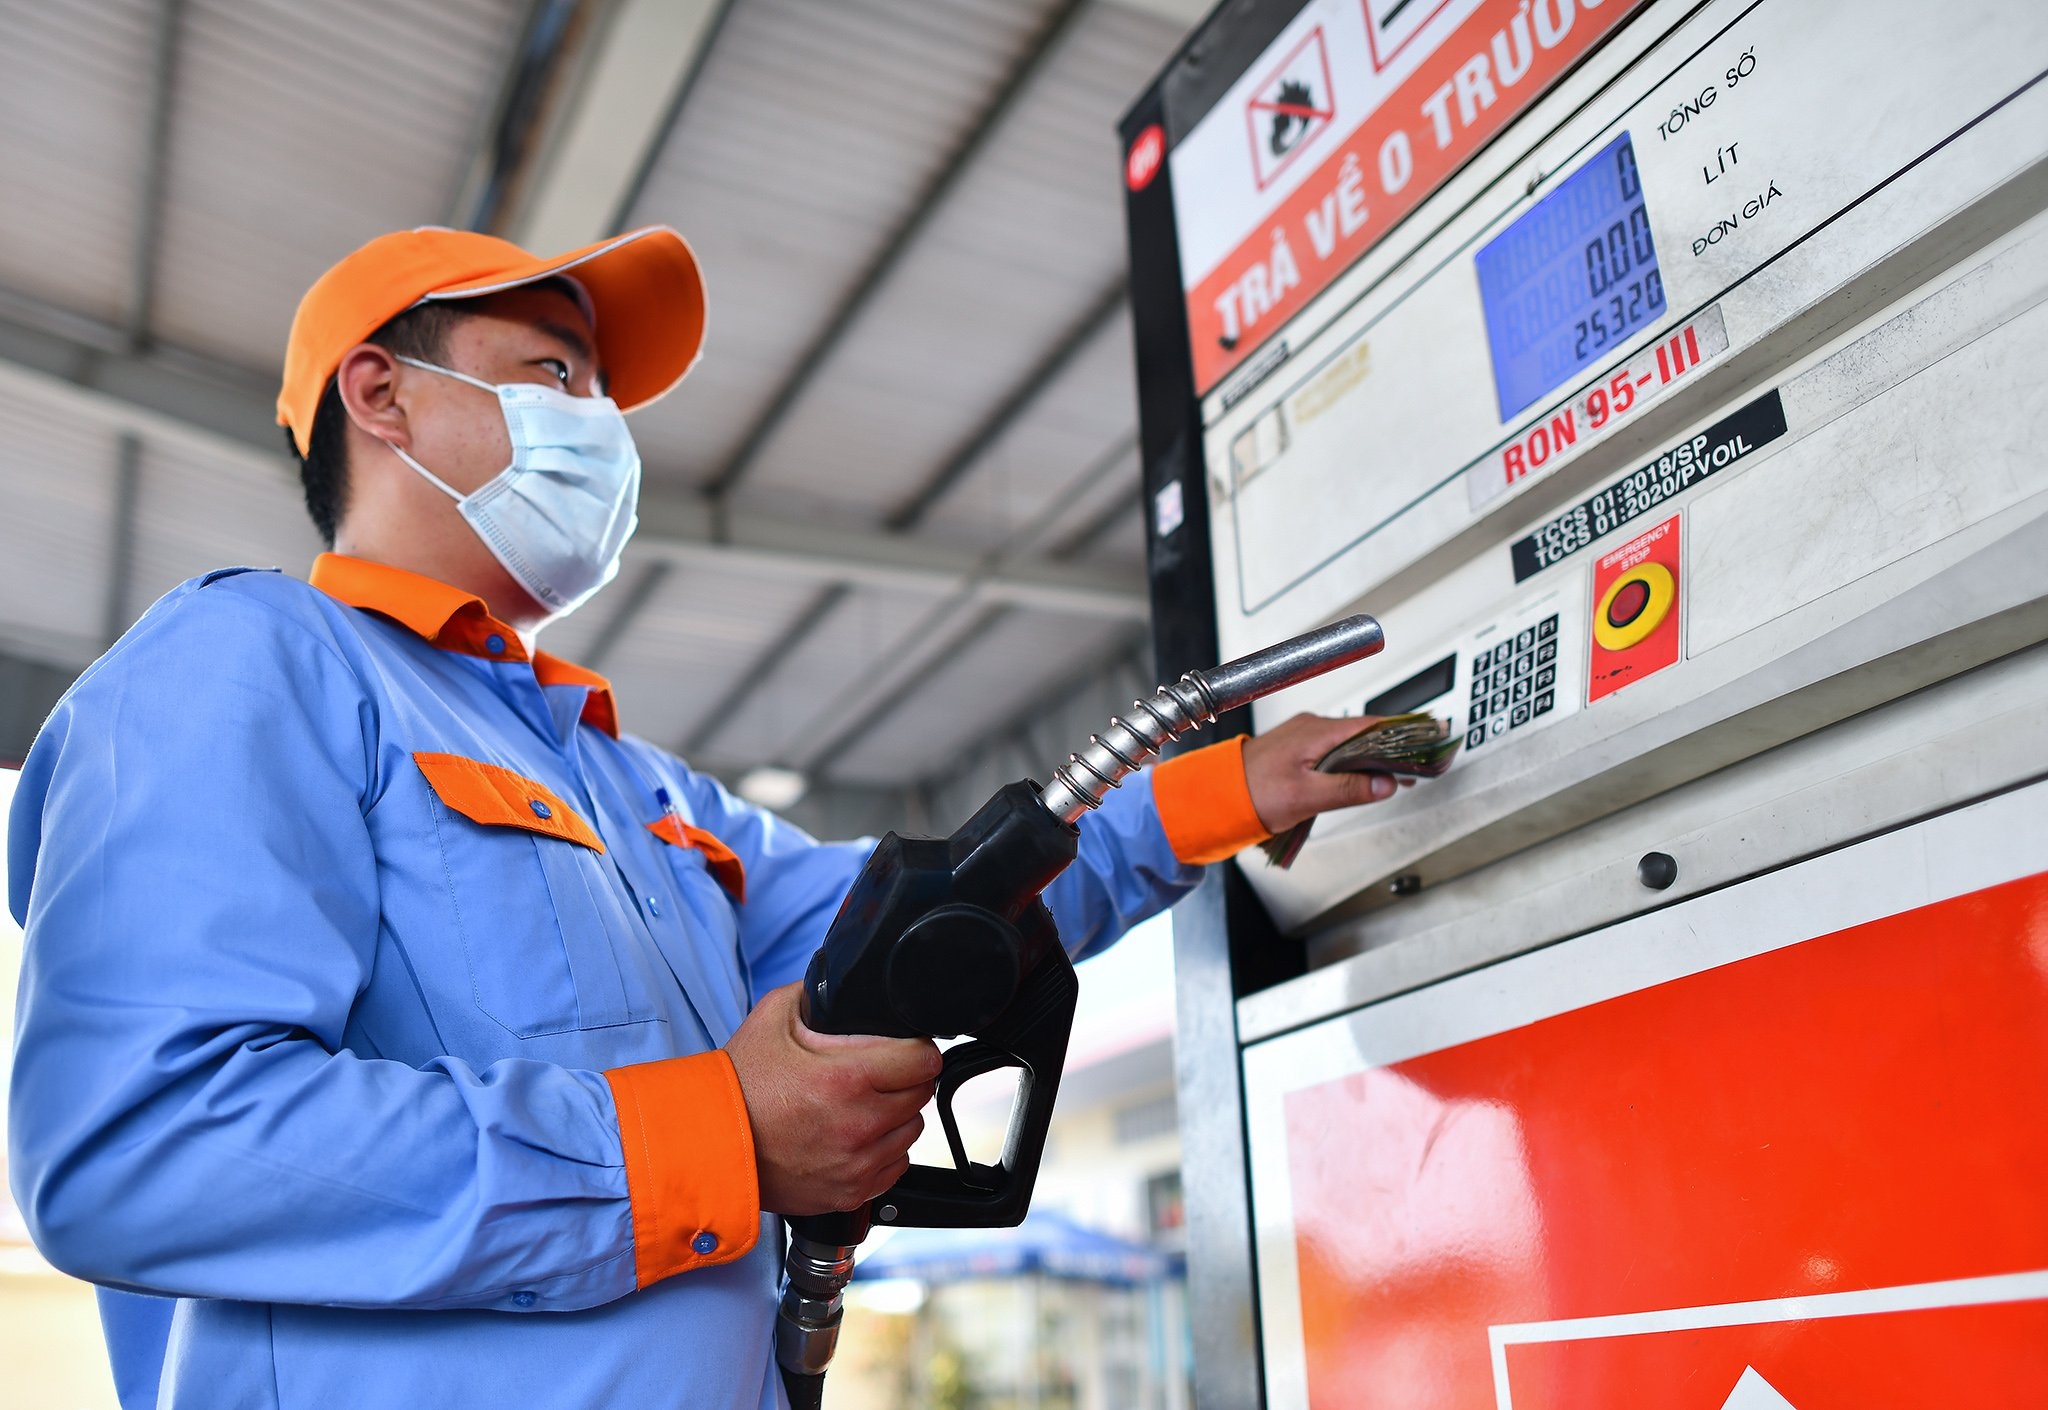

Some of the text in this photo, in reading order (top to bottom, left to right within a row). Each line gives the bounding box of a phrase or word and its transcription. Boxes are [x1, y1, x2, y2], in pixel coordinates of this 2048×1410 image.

[1657, 45, 1756, 141] TỔNG SỐ
[1616, 142, 1641, 202] 0
[1703, 142, 1739, 185] LÍT
[1692, 179, 1782, 256] ĐƠN GIÁ
[1214, 225, 1301, 342] TRẢ
[1575, 268, 1664, 361] 25320
[1502, 325, 1700, 485] RON 95-III
[1532, 434, 1708, 547] TCCS 01:2018/SP
[1534, 524, 1592, 568] TCCS
[1602, 521, 1671, 569] EMERGENCY
[1621, 546, 1651, 571] STOP
[1477, 620, 1555, 672] 7 8 9 F1
[1473, 669, 1553, 721] 1 2 3 F3
[1474, 679, 1486, 696] 4
[1497, 667, 1507, 686] 5
[1518, 655, 1530, 674] 6
[1470, 728, 1481, 747] 0
[1492, 718, 1504, 735] C
